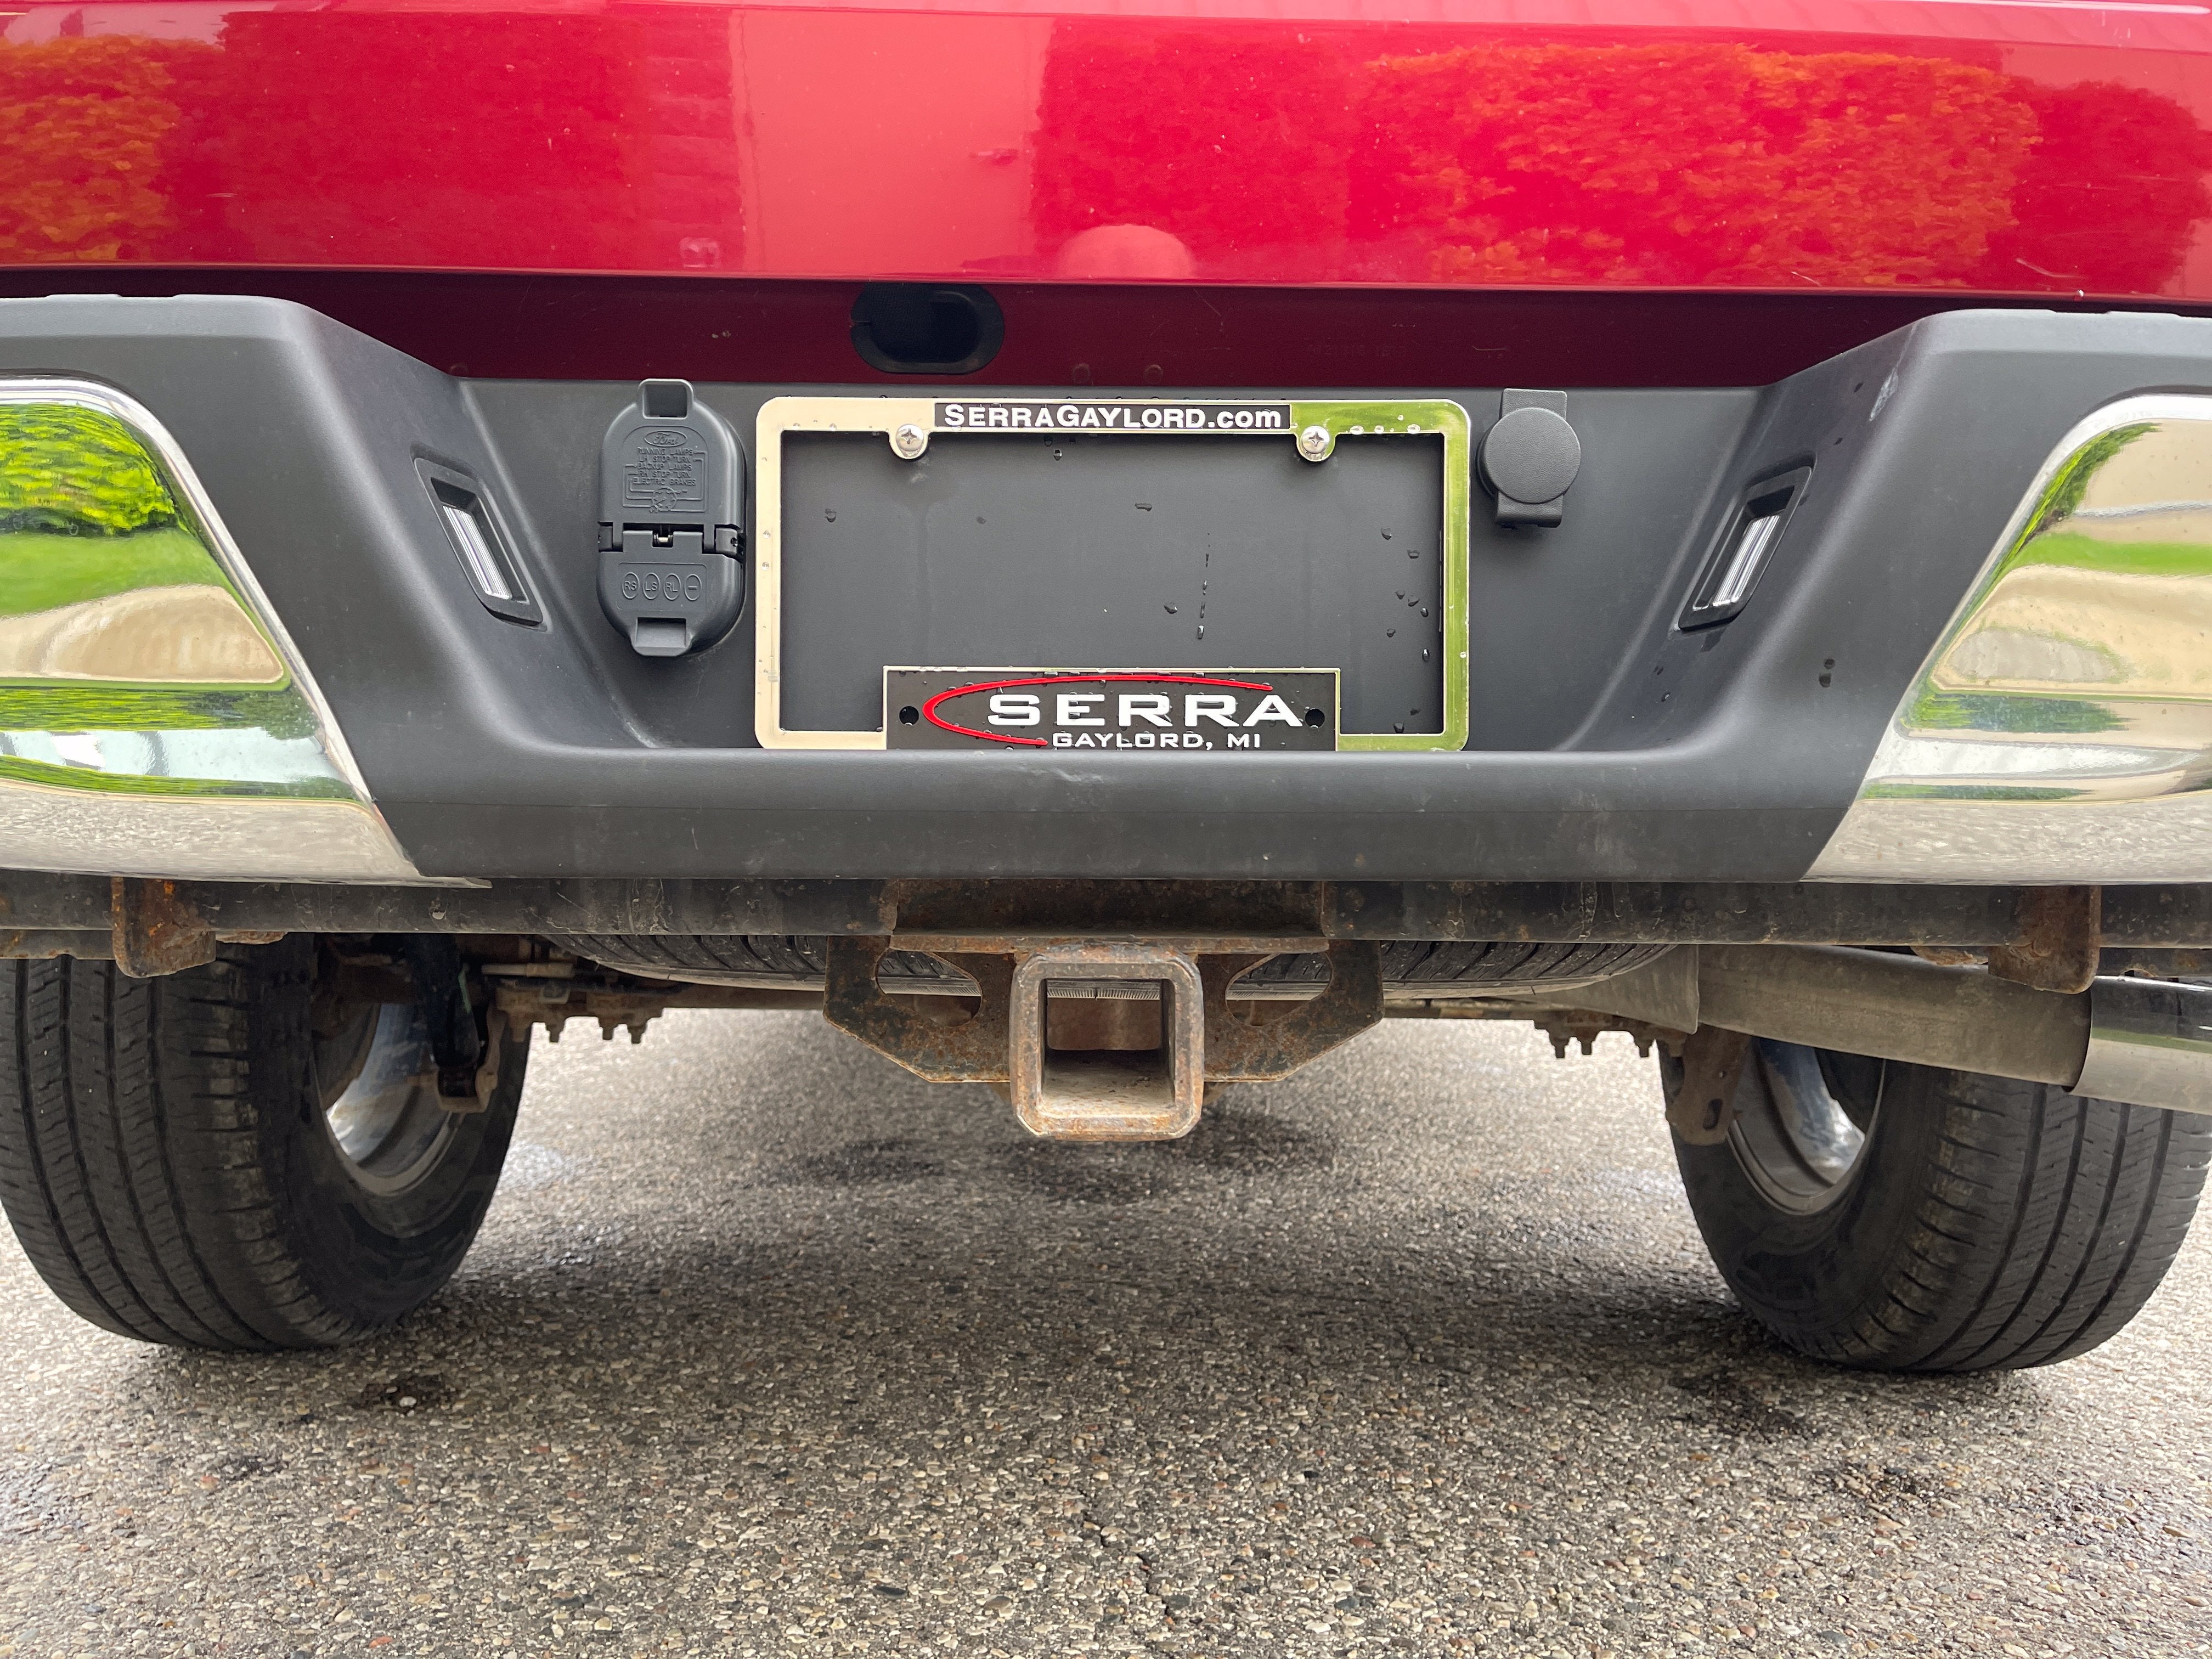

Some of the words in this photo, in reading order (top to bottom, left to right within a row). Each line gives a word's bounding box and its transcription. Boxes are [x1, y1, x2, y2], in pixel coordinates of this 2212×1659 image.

[944, 404, 1282, 428] SERRAGAYLORD.com
[653, 433, 678, 444] Ford
[637, 447, 666, 455] RUNNING
[670, 448, 693, 456] LAMPS
[637, 462, 664, 470] BACKUP
[673, 470, 691, 478] TURN
[633, 477, 665, 485] ELECTRIC
[624, 580, 637, 590] RS
[645, 581, 657, 591] LS
[666, 582, 678, 592] RL
[988, 693, 1303, 727] SERRA
[1052, 732, 1213, 751] GAYLORD,
[1227, 733, 1261, 748] MI
